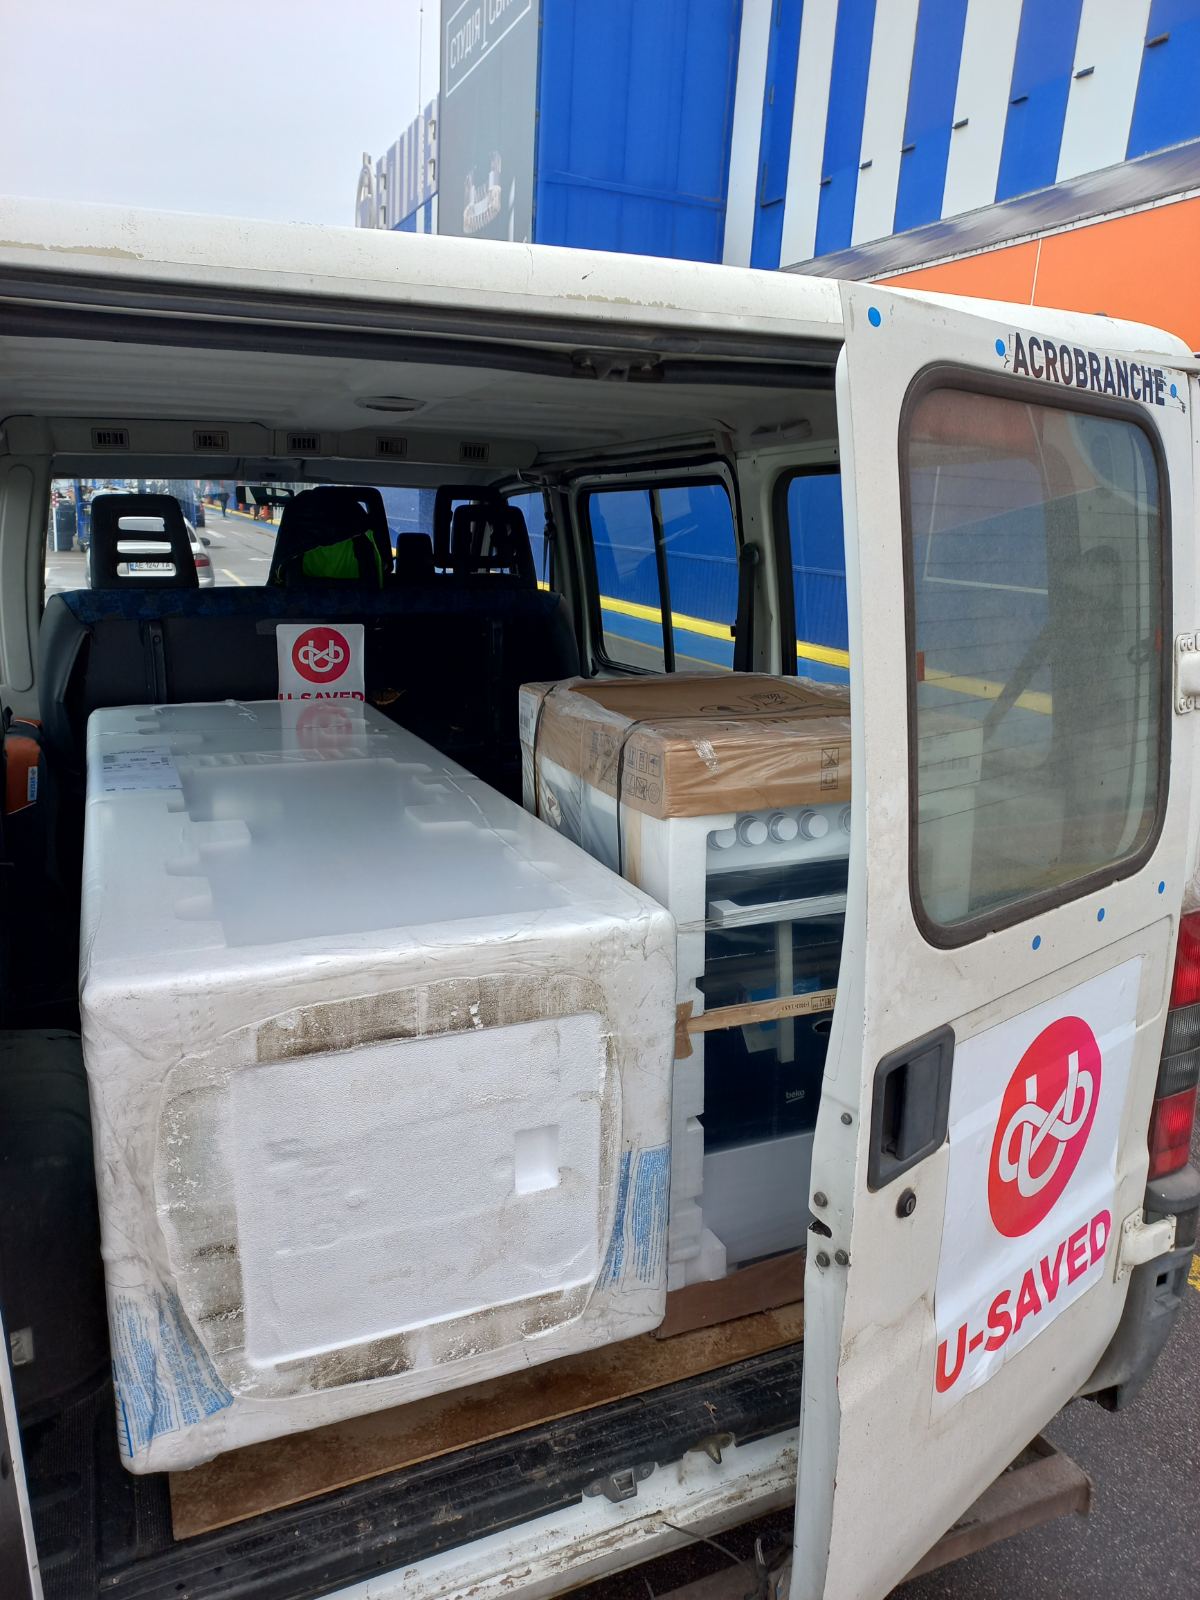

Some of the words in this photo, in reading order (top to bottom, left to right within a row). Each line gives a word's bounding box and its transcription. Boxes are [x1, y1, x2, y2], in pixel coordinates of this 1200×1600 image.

[1013, 332, 1166, 406] ACROBRANCHE
[785, 1088, 806, 1101] beko
[935, 1209, 1112, 1394] U-SAVED
